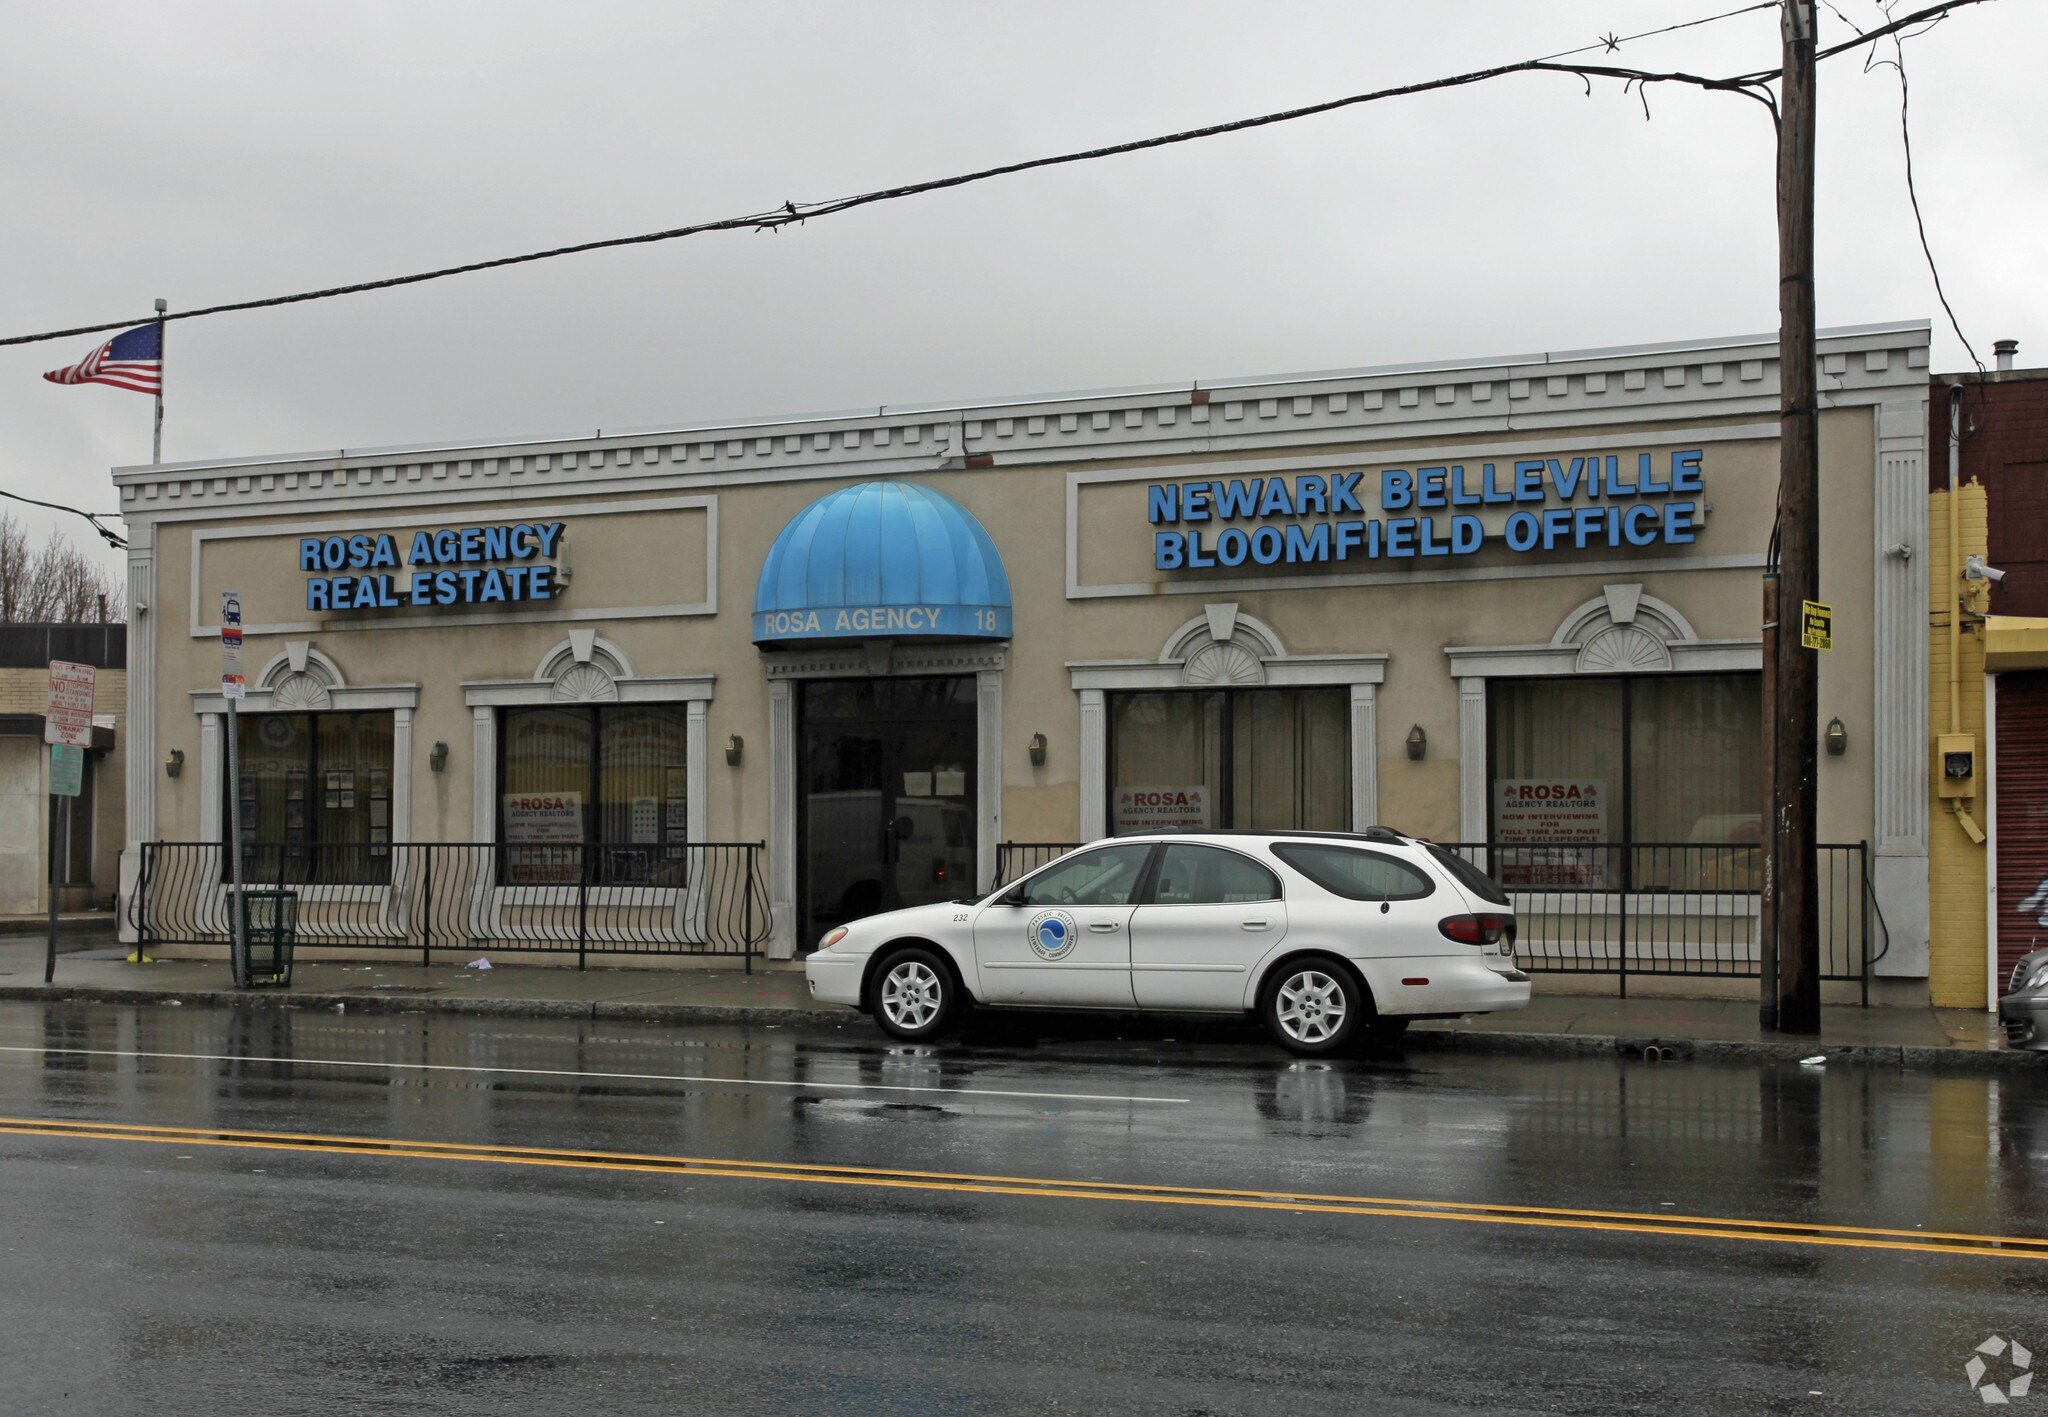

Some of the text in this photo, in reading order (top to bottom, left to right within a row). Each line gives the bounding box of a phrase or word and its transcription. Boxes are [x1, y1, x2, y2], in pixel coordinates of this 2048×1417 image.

[1148, 449, 1703, 524] NEWARK BELLEVILLE
[1155, 502, 1696, 570] BLOOMFIELD OFFICE
[300, 522, 565, 571] ROSA AGENCY
[307, 565, 555, 610] REAL ESTATE
[765, 607, 997, 634] ROSA AGENCY 18
[66, 665, 93, 676] PARKING
[51, 680, 66, 693] NO
[66, 689, 92, 698] STANDING
[55, 724, 85, 734] TOWAWAY
[60, 731, 77, 740] ZONE
[1519, 784, 1582, 799] ROSA
[520, 797, 564, 810] ROSA
[1134, 792, 1188, 806] ROSA
[1545, 800, 1596, 808] REALTORS
[1157, 806, 1201, 814] REALTORS
[953, 914, 968, 922] 232
[1032, 912, 1072, 926] PASSAIC VALLEY
[1030, 934, 1074, 958] SEWERAGE COMMISSIONERS
